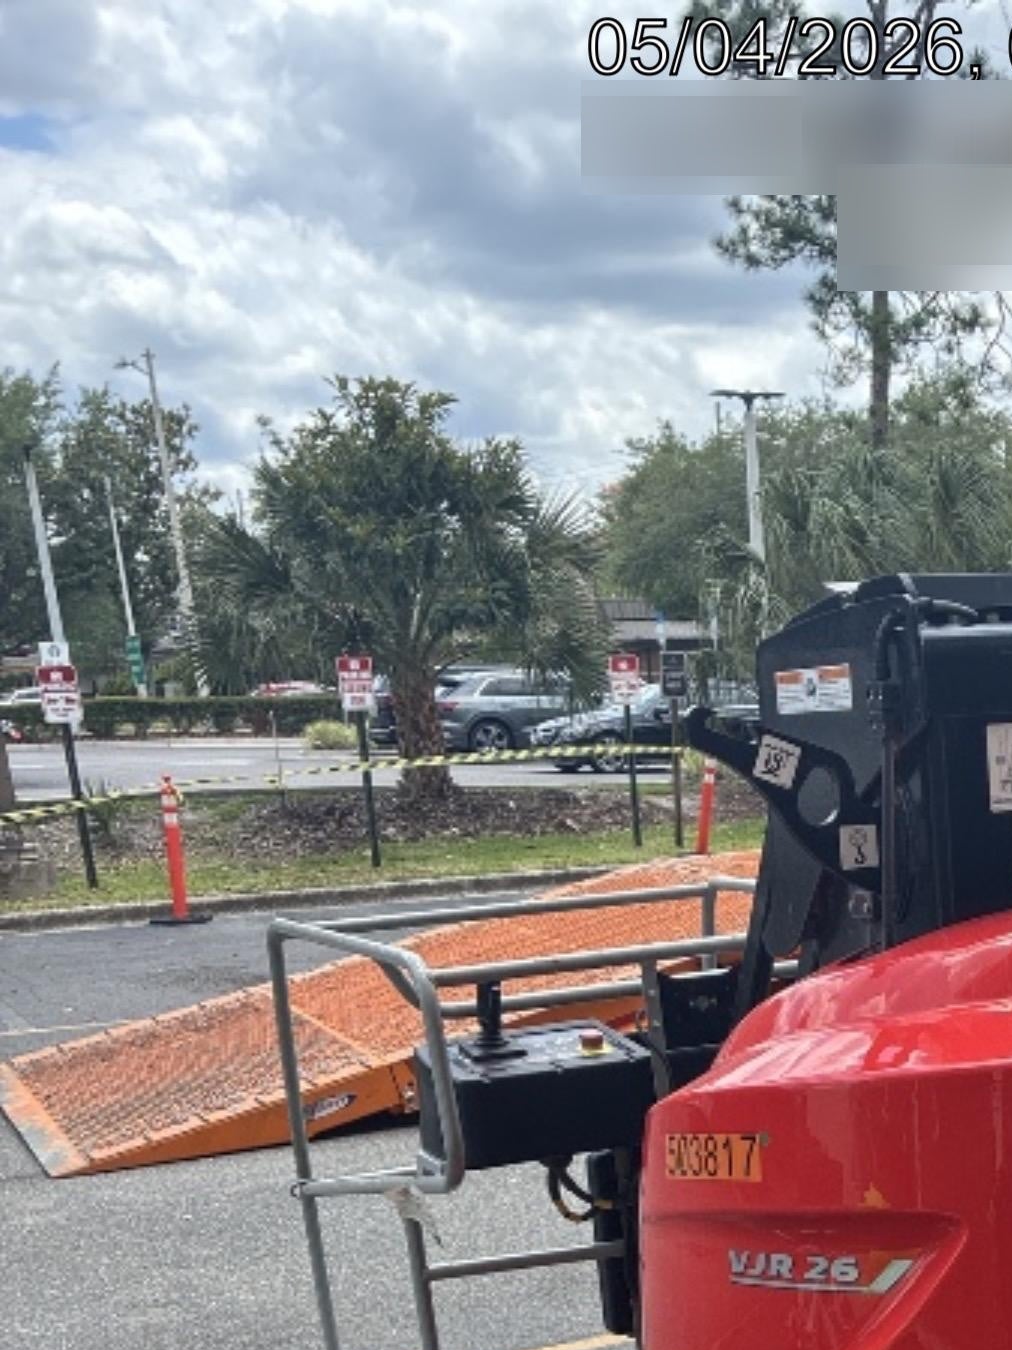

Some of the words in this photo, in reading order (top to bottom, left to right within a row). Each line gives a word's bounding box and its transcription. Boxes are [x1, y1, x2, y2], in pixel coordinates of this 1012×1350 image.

[668, 1135, 757, 1177] 503817
[728, 1249, 793, 1280] VJR
[803, 1255, 860, 1283] 26
